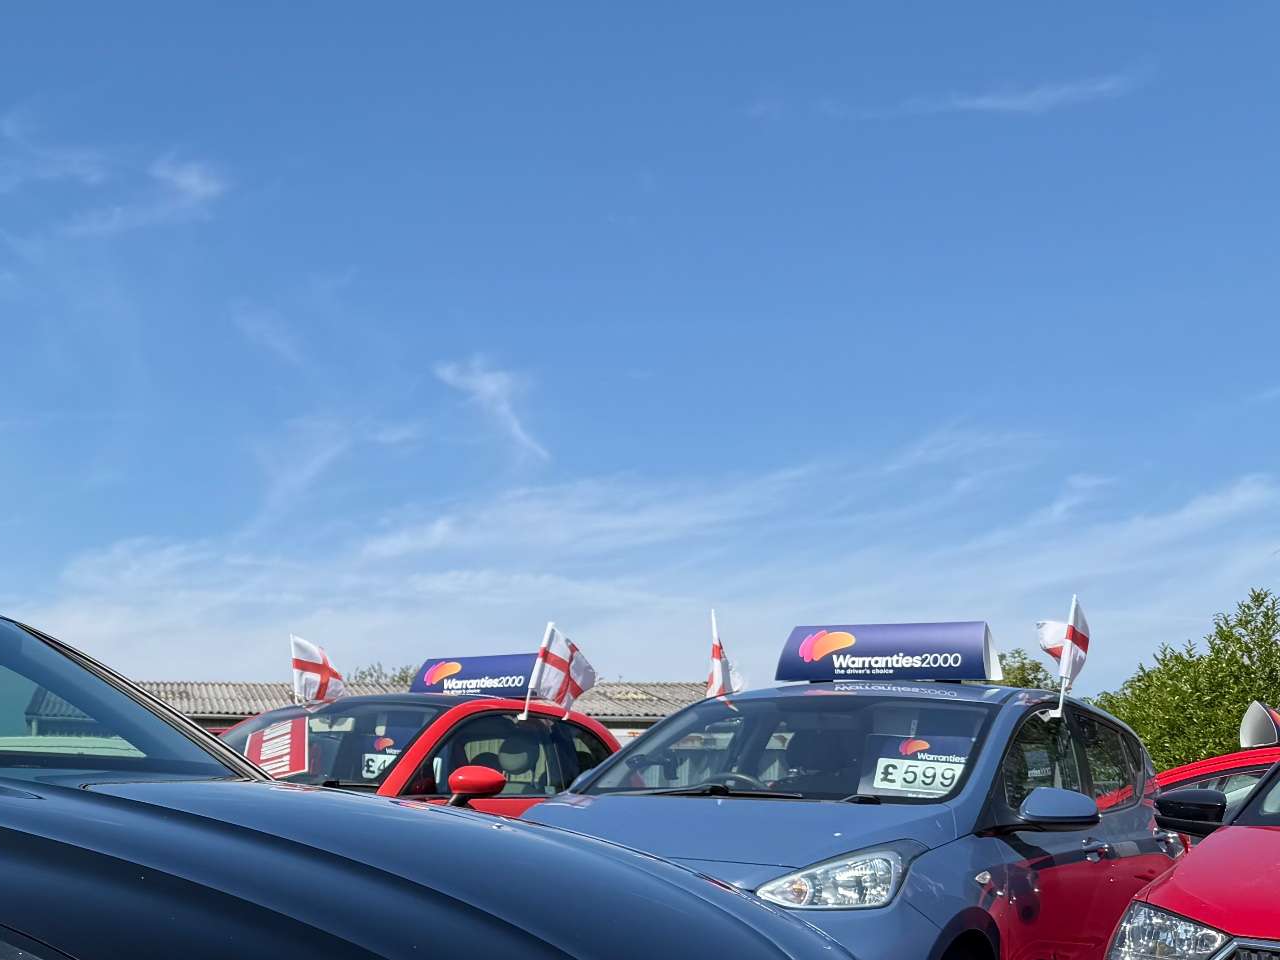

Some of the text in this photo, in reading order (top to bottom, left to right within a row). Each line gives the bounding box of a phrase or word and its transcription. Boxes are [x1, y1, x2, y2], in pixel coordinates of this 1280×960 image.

[832, 652, 962, 668] Warranties2000
[443, 676, 525, 690] Warranties2000
[917, 752, 968, 763] Warranties
